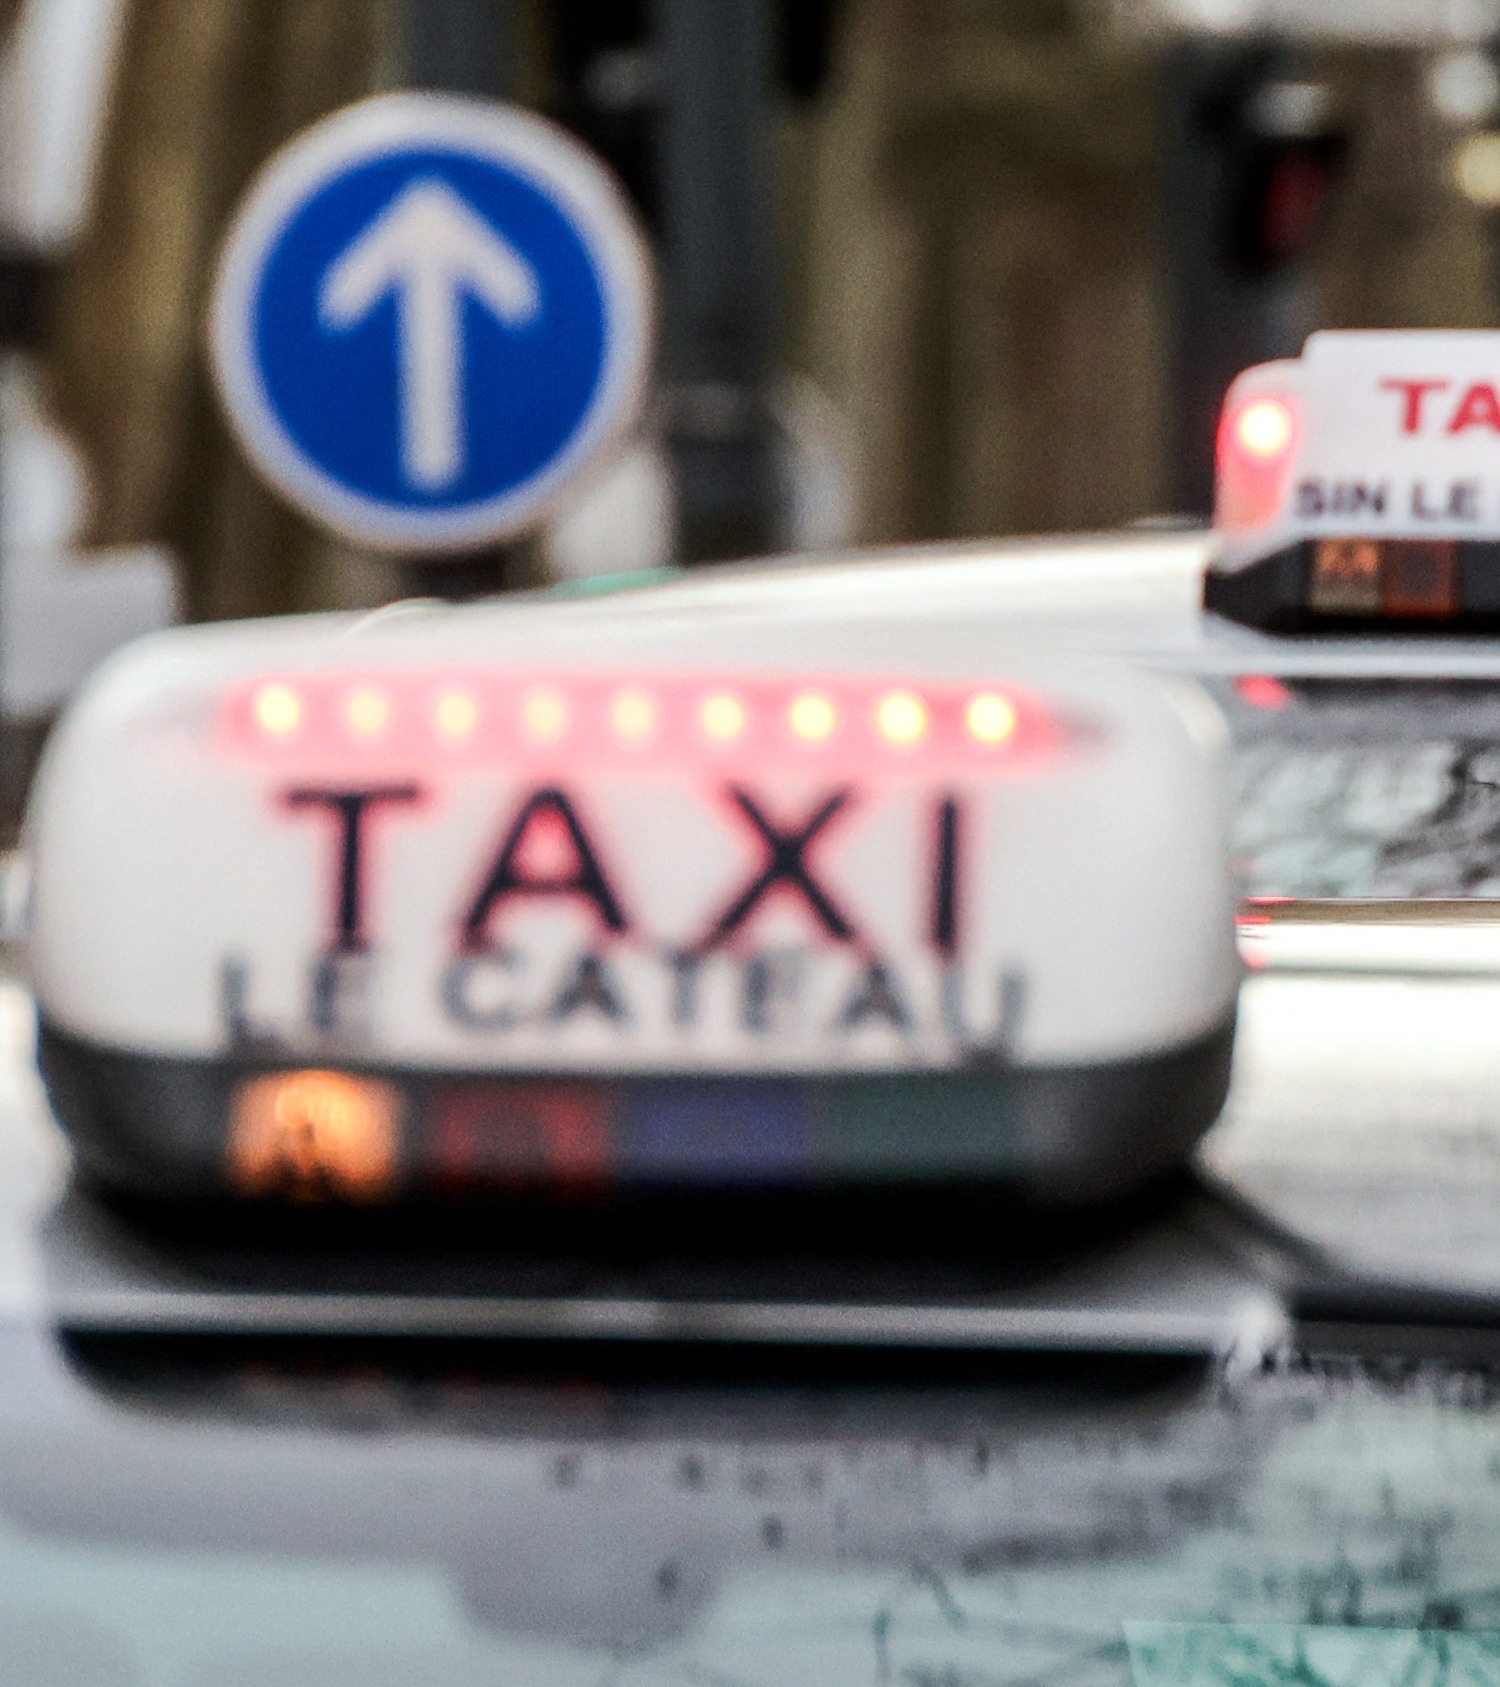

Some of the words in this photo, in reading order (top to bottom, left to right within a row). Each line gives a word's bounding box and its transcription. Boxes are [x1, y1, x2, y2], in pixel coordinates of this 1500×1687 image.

[1298, 479, 1386, 520] SIN
[1413, 480, 1478, 522] LE
[280, 786, 966, 955] TAXI
[222, 950, 376, 1052] LE
[442, 946, 1030, 1060] CATEAU
